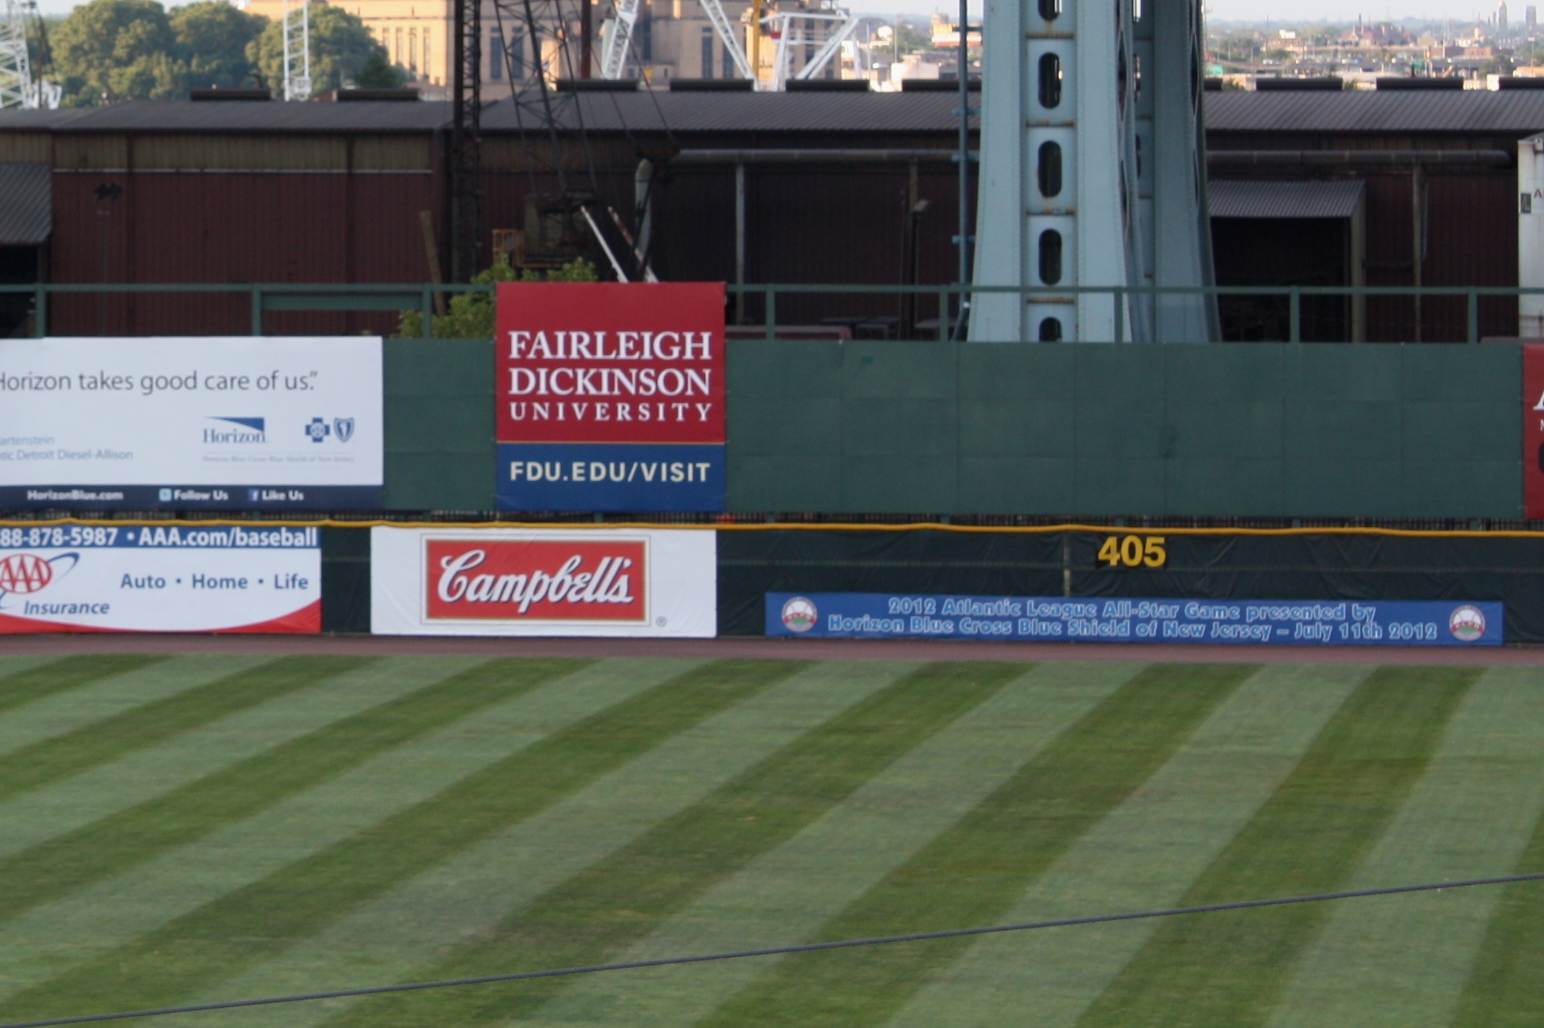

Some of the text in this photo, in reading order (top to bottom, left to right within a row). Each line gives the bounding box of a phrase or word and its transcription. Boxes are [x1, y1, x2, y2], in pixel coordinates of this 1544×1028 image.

[508, 330, 712, 360] FAIRLEIGH
[79, 371, 134, 390] takes
[141, 371, 197, 396] good
[205, 375, 250, 390] care
[257, 370, 279, 390] of
[508, 367, 712, 396] DICKINSON
[509, 402, 712, 422] UNIVERSITY
[203, 428, 265, 443] Horizon
[16, 450, 54, 460] Detroit
[510, 461, 711, 482] FDU.EDU/VISIT
[27, 490, 123, 501] HorizonBlue.com
[174, 490, 228, 501] Follow Us
[262, 490, 286, 501] Like
[288, 490, 304, 501] Us
[138, 527, 317, 548] AAA.com/baseball
[1098, 535, 1166, 567] 405
[120, 574, 309, 589] Auto Home Life
[437, 549, 634, 614] Campbell's
[24, 601, 110, 615] Insurance
[888, 597, 1376, 624] 2012 Atlantic League All-Star Game presented by
[828, 614, 904, 633] Horizon
[910, 615, 954, 634] Blue
[958, 617, 1013, 635] Cross
[1018, 618, 1062, 636] Blue
[1067, 619, 1131, 638] Shield
[1135, 619, 1158, 638] of
[1162, 620, 1206, 638] New
[1210, 620, 1272, 642] Jersey
[1294, 622, 1333, 643] July
[1338, 621, 1383, 640] 11th
[1388, 621, 1438, 640] 2012
